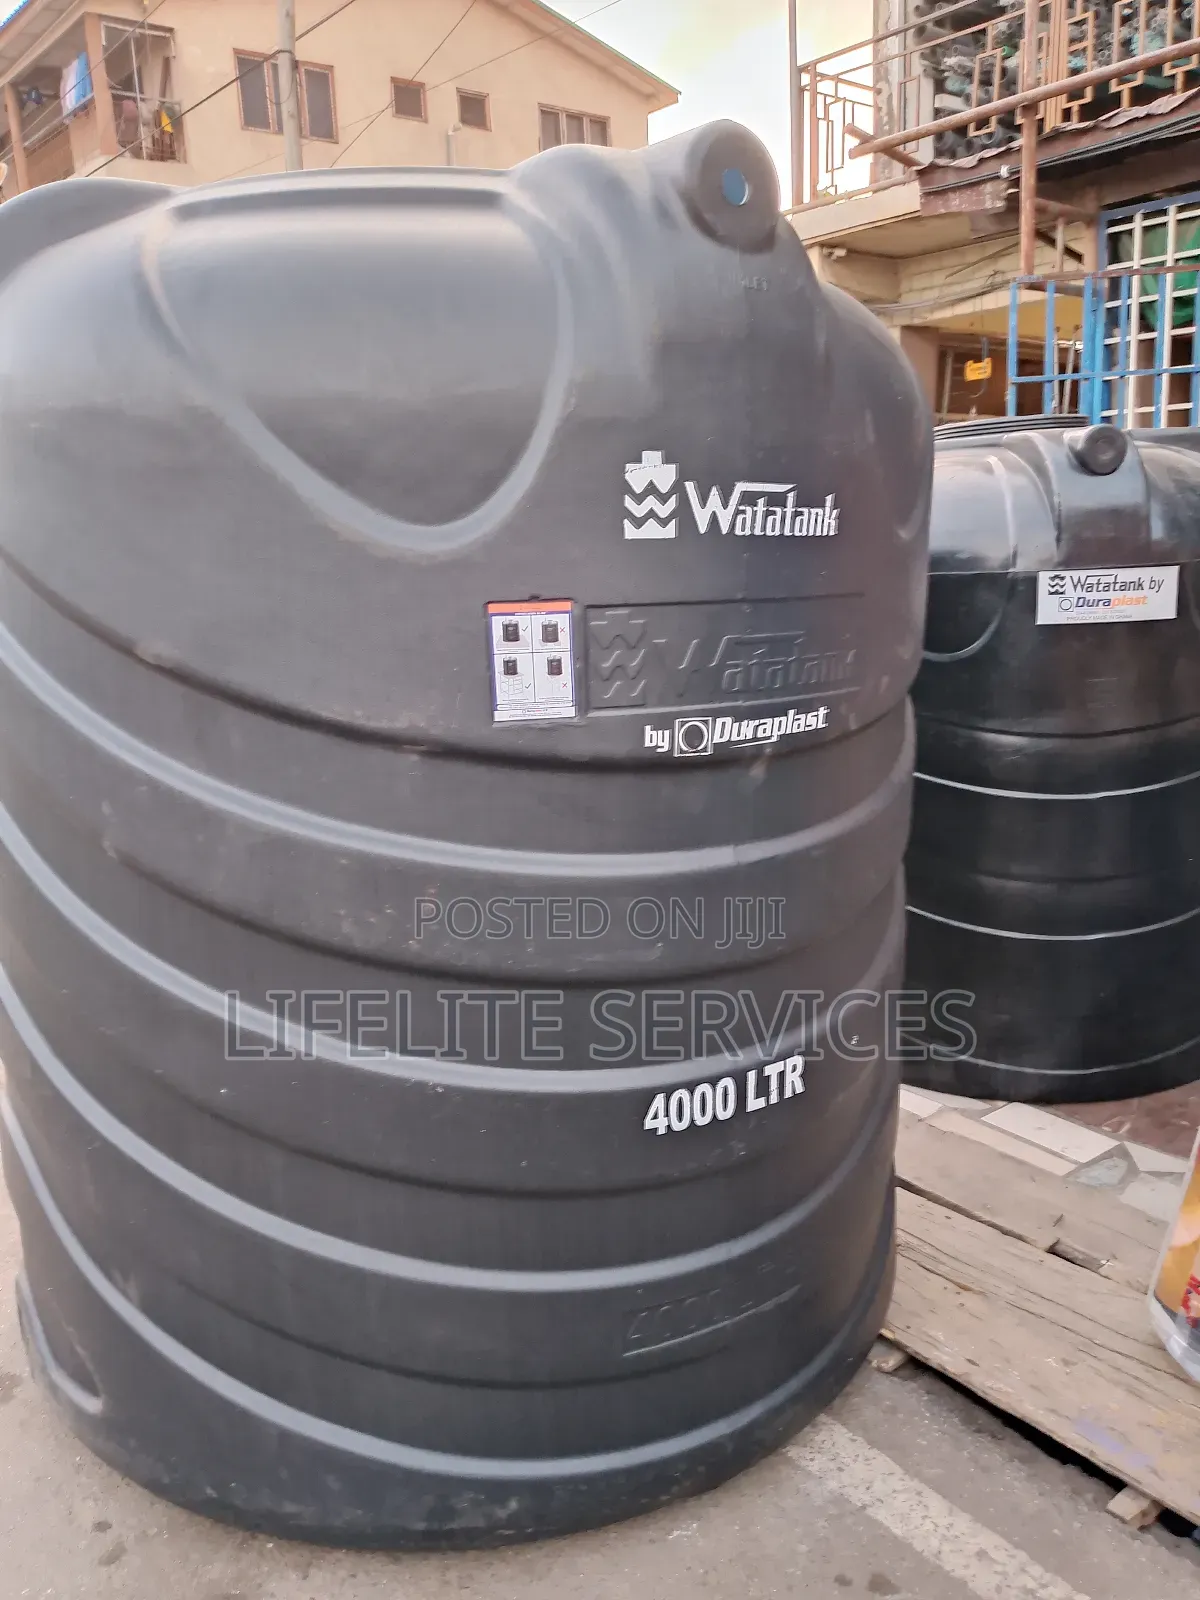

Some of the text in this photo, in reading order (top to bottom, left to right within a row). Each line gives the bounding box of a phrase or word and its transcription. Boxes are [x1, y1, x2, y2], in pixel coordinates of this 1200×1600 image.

[684, 480, 841, 537] Watatank
[1069, 573, 1165, 593] Watatank by
[1075, 595, 1148, 609] Duraplast
[643, 705, 831, 753] by Duraplast
[643, 1054, 806, 1136] 4000 LTR
